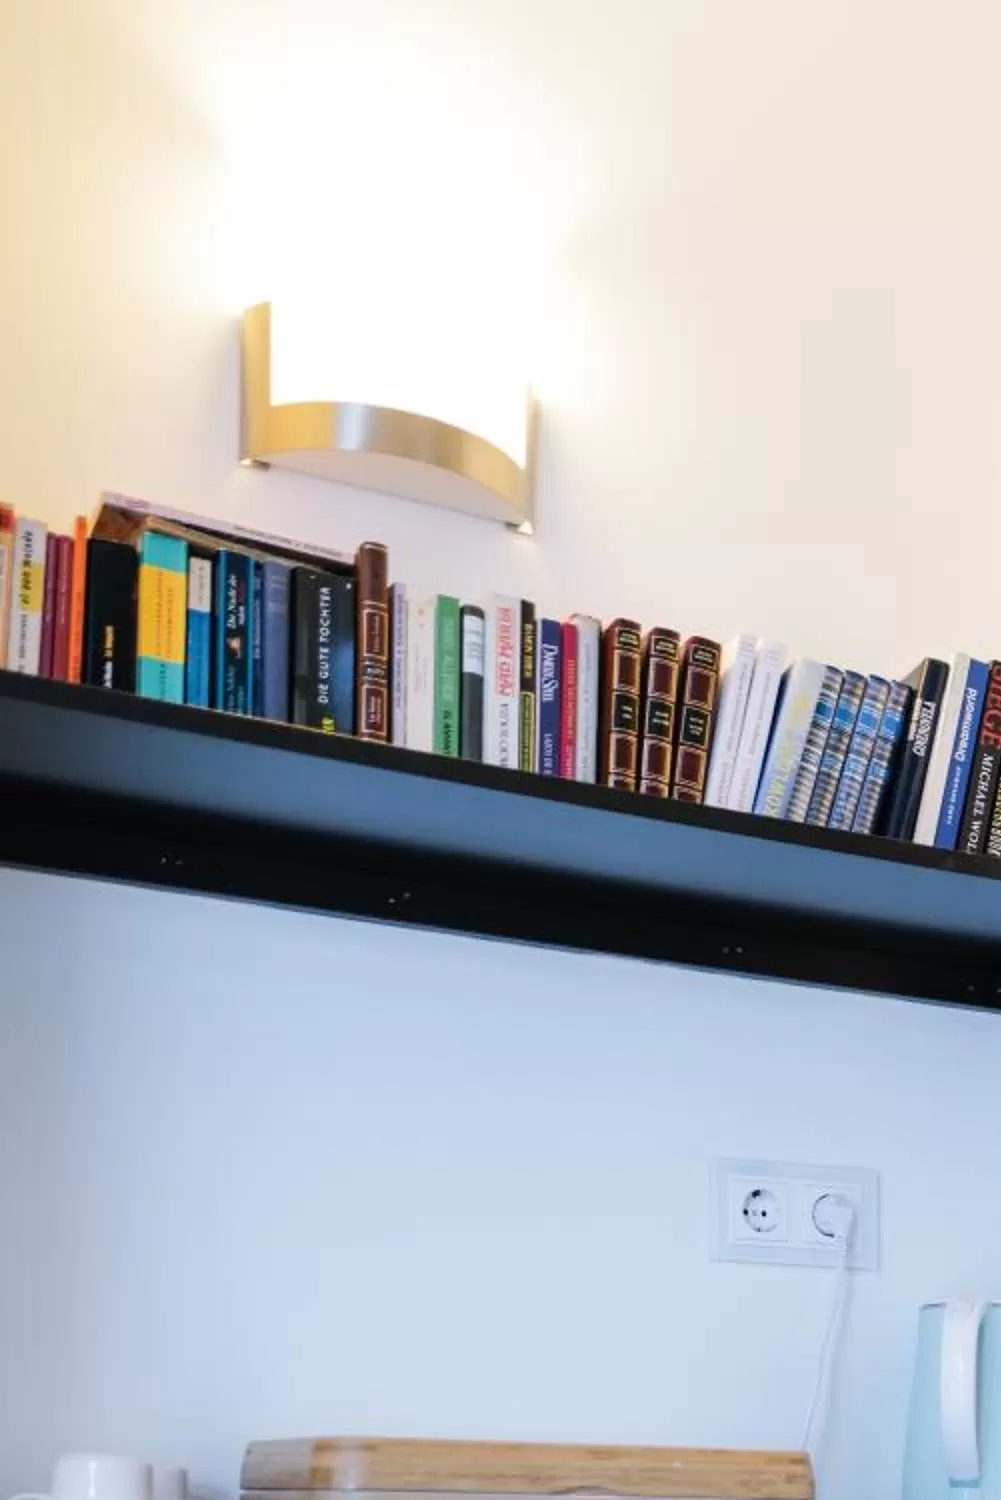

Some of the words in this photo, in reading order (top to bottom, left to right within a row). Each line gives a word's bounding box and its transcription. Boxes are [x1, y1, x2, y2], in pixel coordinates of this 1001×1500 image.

[318, 587, 332, 642] TOCHTER
[318, 647, 330, 679] GUTE
[317, 684, 329, 704] DIE
[954, 687, 977, 762] Dreamworld
[974, 754, 995, 816] MICHAEL
